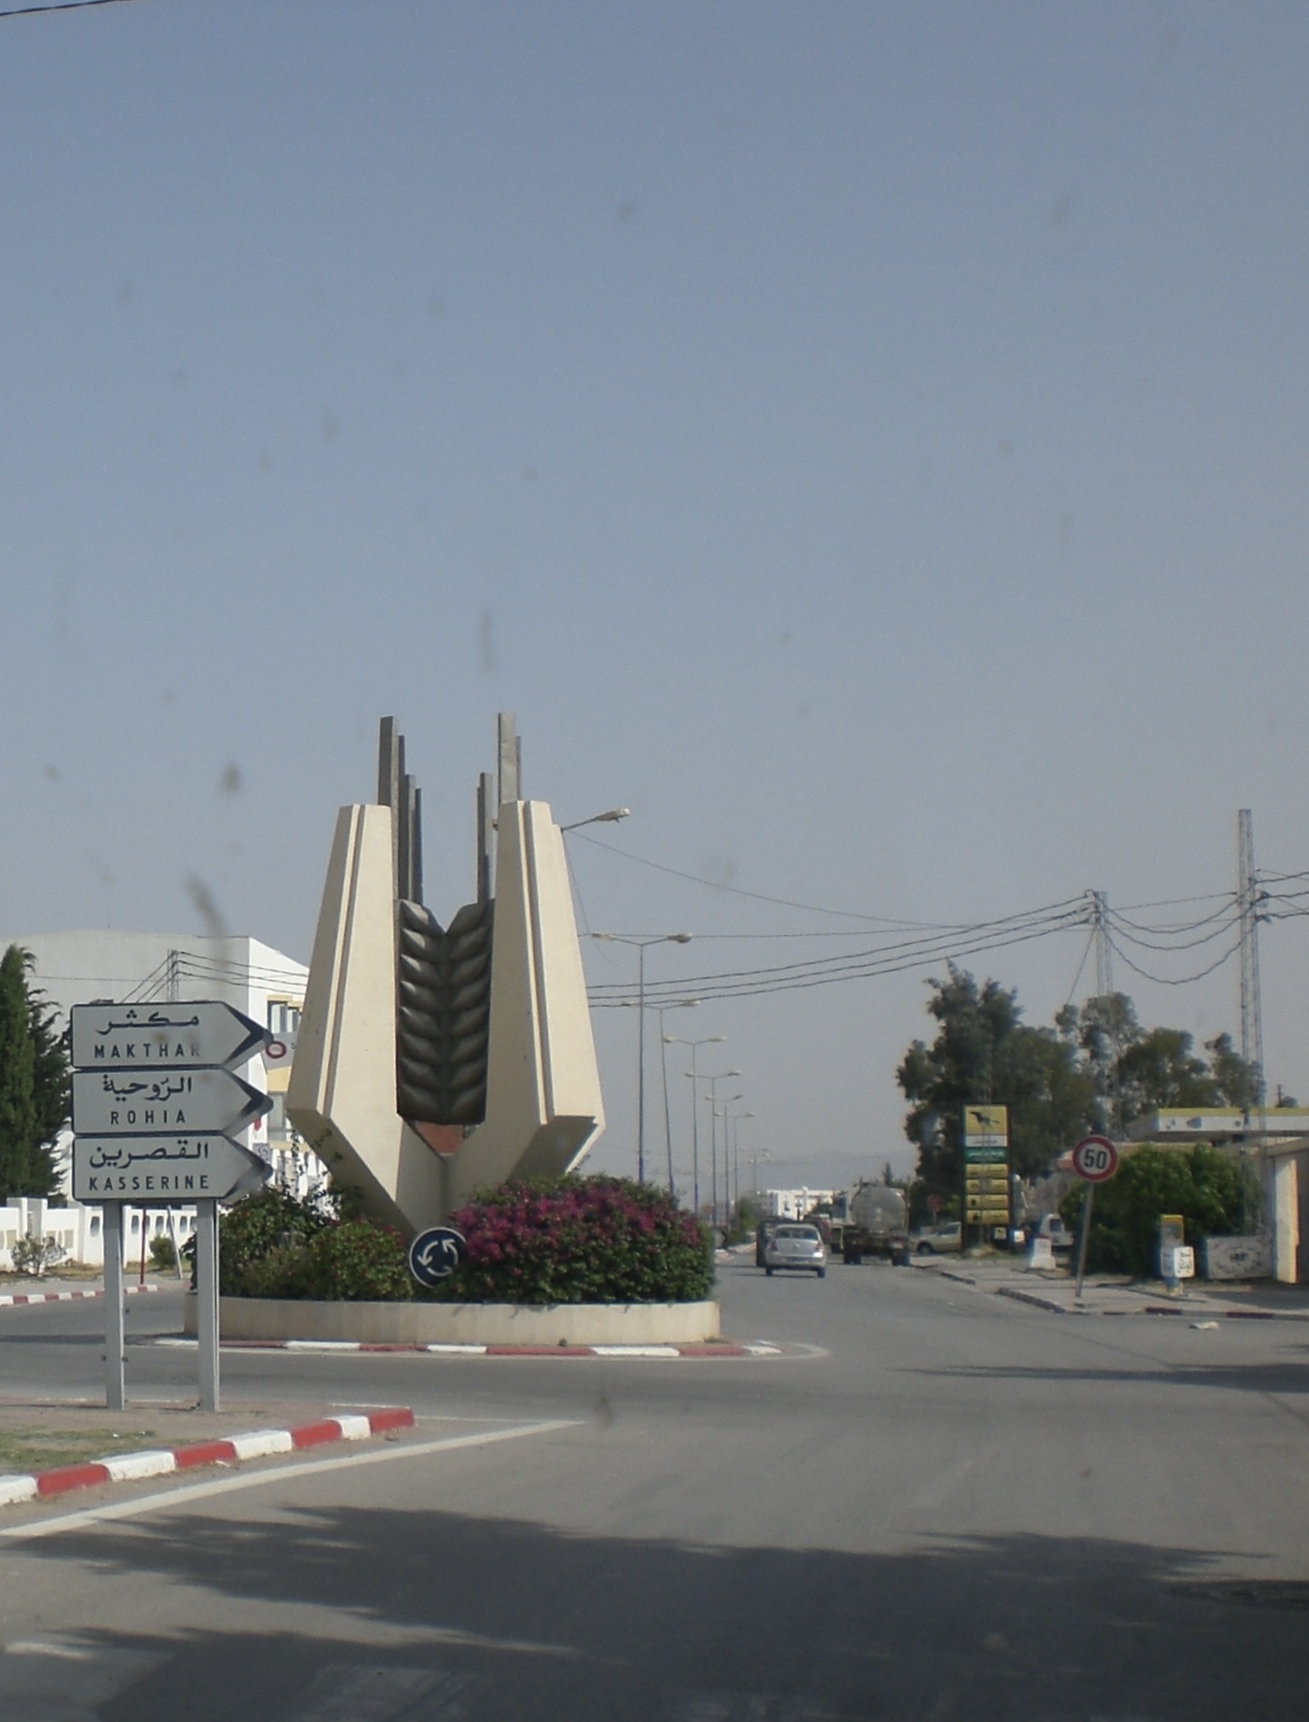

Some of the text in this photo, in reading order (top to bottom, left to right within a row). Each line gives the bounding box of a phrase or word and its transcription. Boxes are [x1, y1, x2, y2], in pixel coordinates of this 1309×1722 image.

[95, 1009, 199, 1035] مكثر
[94, 1043, 201, 1059] MAKTHAR
[110, 1110, 186, 1125] ROHIA
[89, 1139, 209, 1168] القصرين
[1084, 1149, 1107, 1169] 50
[89, 1175, 209, 1191] KASSERINE
